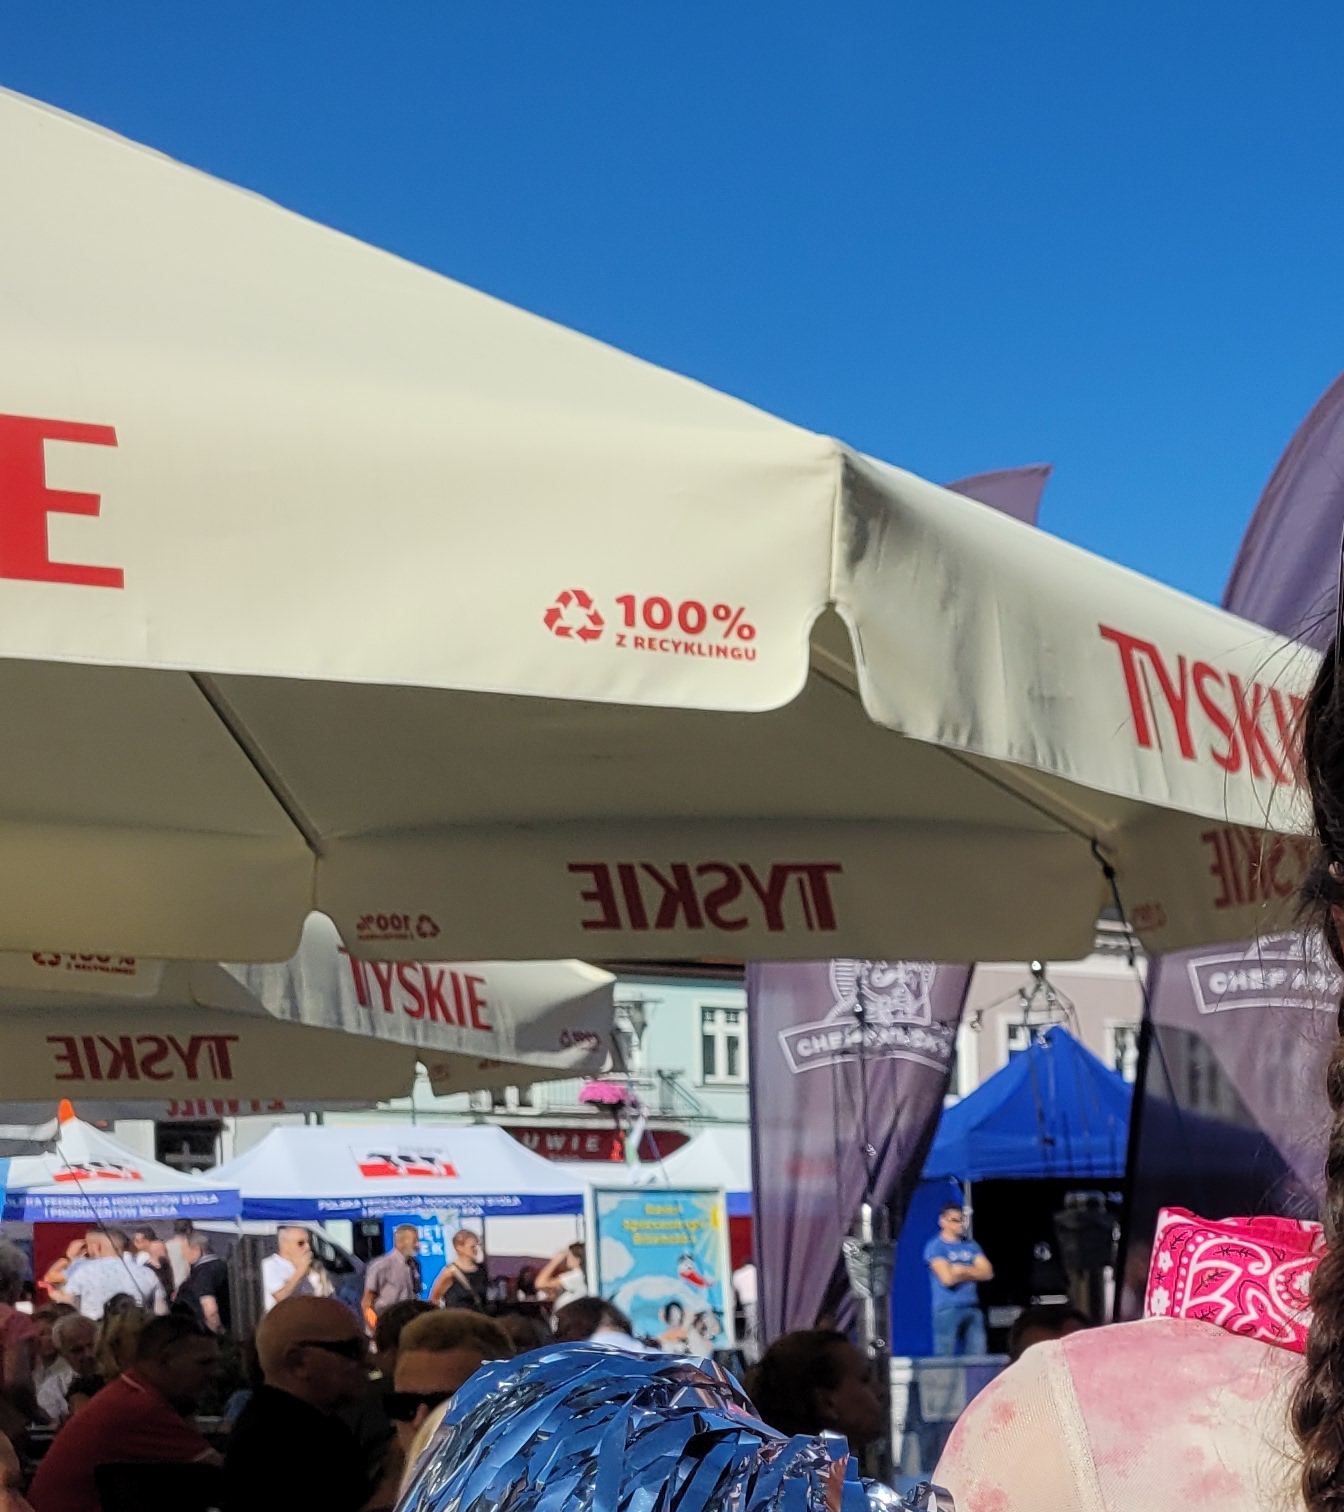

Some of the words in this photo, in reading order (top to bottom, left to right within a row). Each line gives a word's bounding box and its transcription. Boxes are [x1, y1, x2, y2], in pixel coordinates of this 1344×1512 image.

[615, 594, 757, 641] 100%
[616, 633, 627, 648] Z
[634, 636, 757, 662] RECYKLINGU
[338, 946, 493, 1032] TYSKIE
